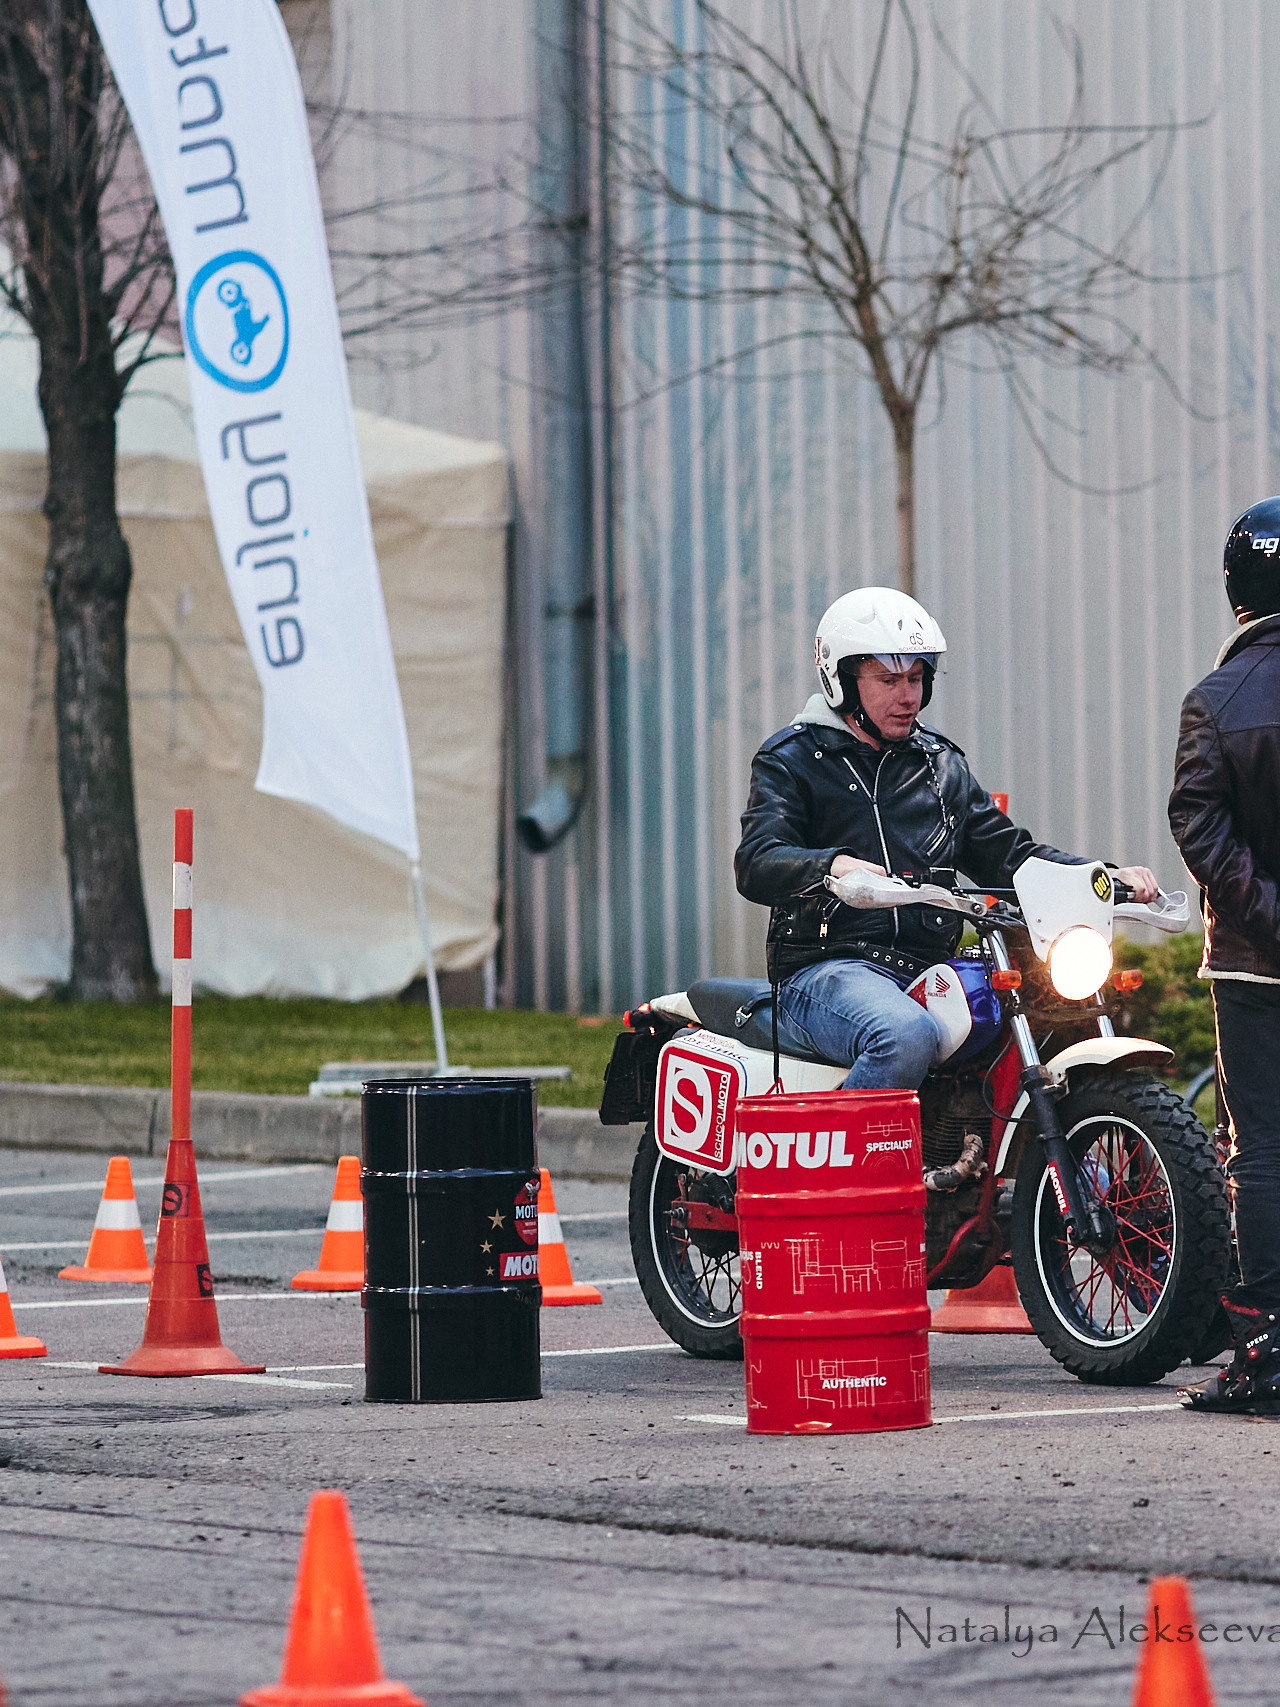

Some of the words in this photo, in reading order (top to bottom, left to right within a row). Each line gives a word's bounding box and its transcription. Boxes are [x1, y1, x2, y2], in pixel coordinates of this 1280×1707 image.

[1252, 537, 1280, 554] ag
[1093, 872, 1110, 897] 001
[866, 1139, 913, 1152] SPECIALIST
[1048, 1166, 1067, 1213] MOTUL
[503, 1254, 539, 1277] MOT
[755, 1251, 763, 1290] BLEND
[1246, 1333, 1269, 1349] SPEED
[822, 1376, 887, 1389] AUTHENTIC
